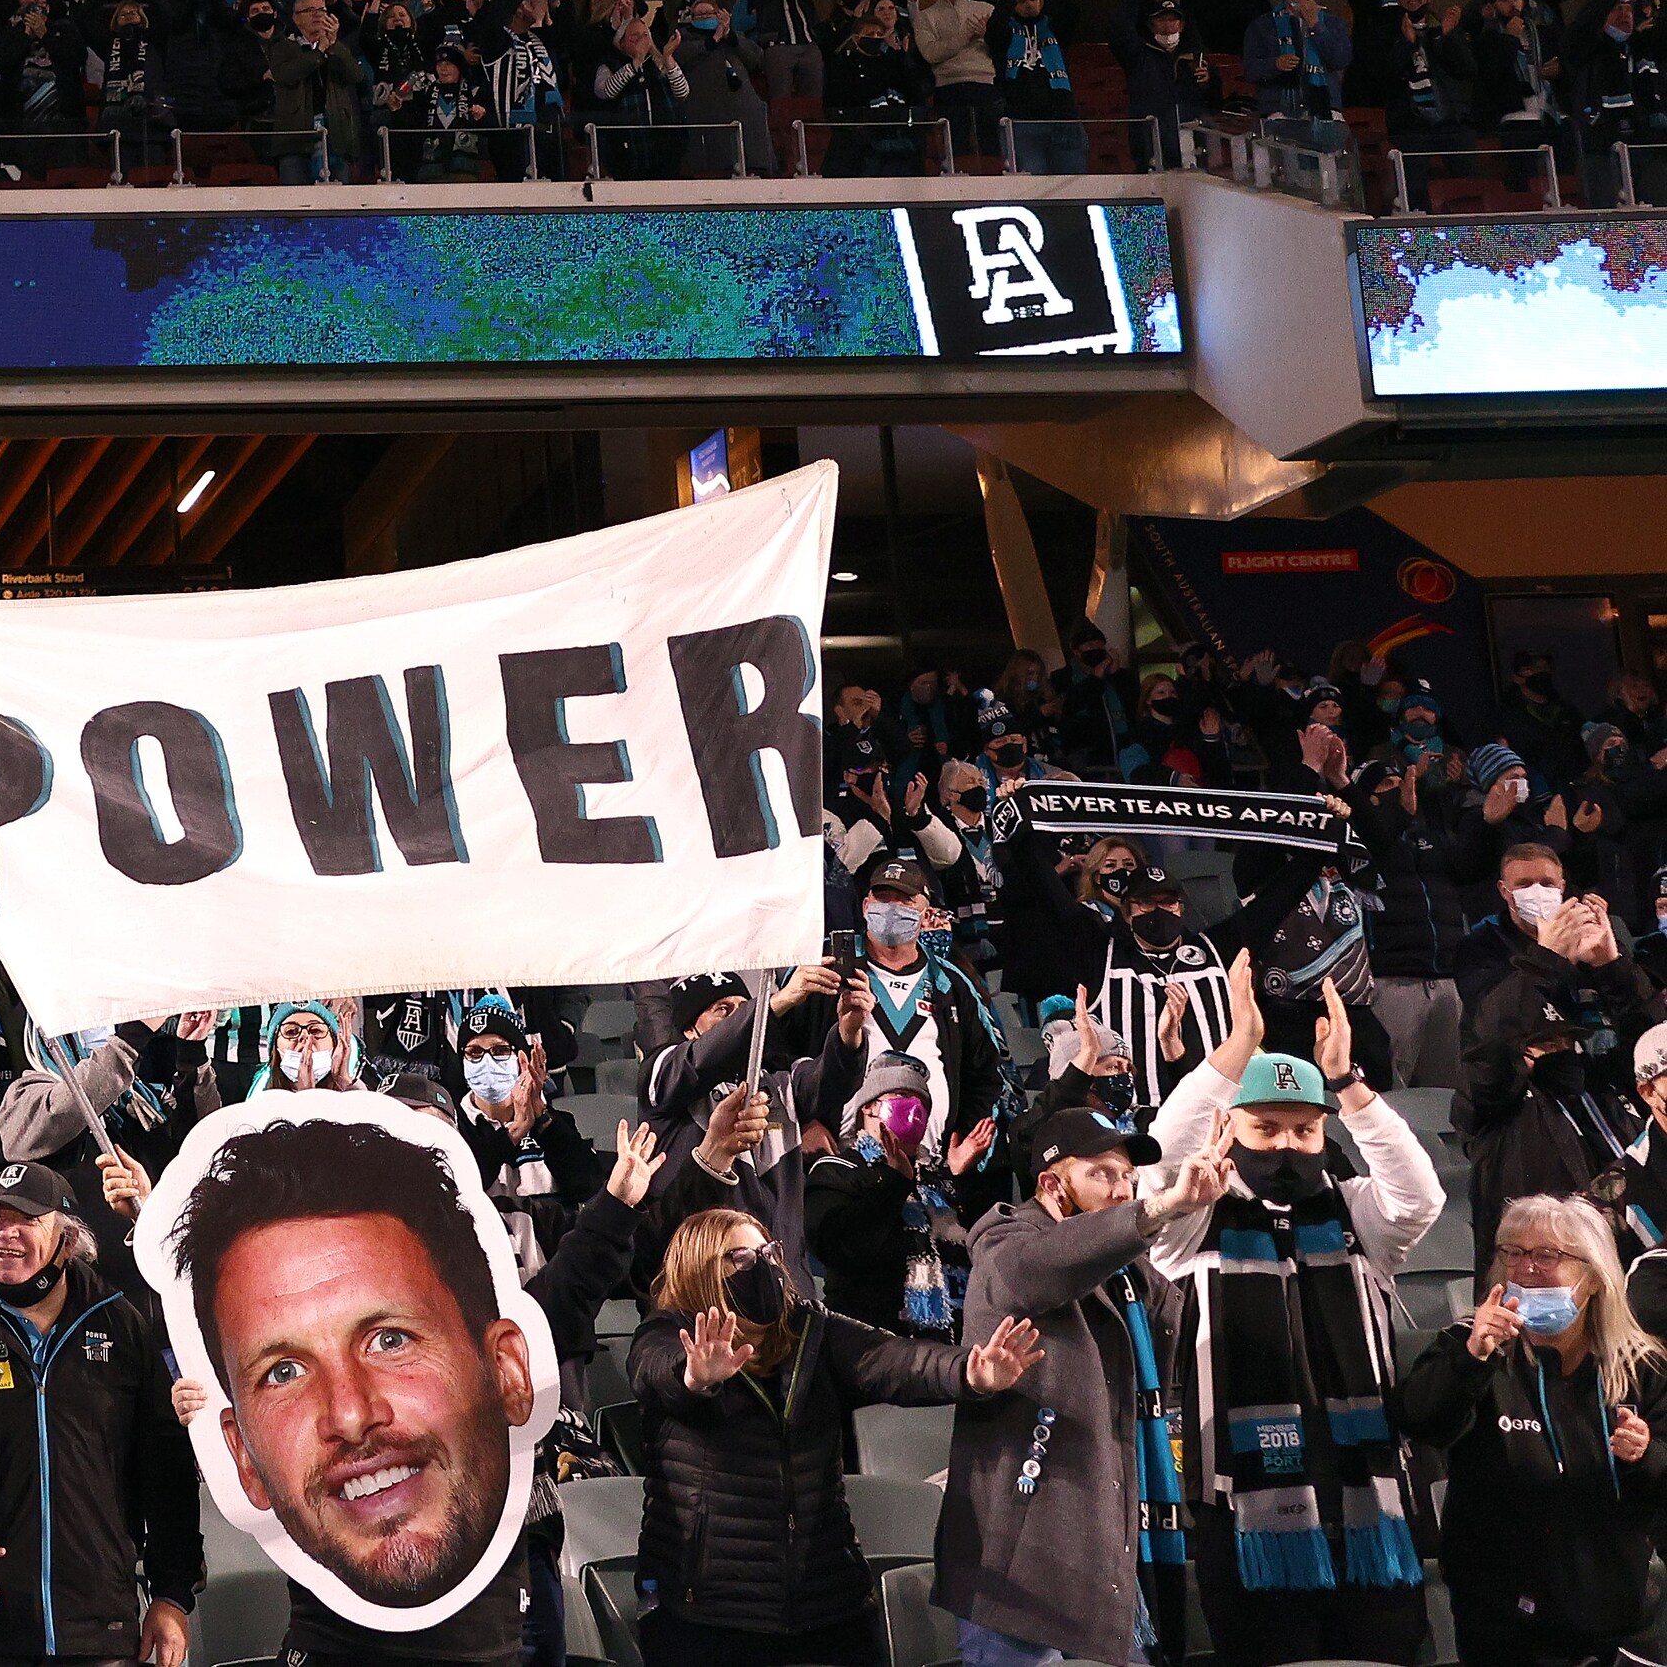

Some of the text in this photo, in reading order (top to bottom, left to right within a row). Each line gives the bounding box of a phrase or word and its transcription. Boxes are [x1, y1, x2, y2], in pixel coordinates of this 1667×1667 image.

[1228, 552, 1352, 570] FLIGHT CENTRE
[2, 573, 84, 584] Riverbank Stand
[1030, 795, 1335, 831] NEVER TEAR US APART
[889, 980, 908, 991] ISC
[85, 1330, 108, 1340] POWER
[1257, 1423, 1297, 1434] MEMBER
[1512, 1419, 1542, 1433] GFG
[1259, 1432, 1301, 1449] 2018
